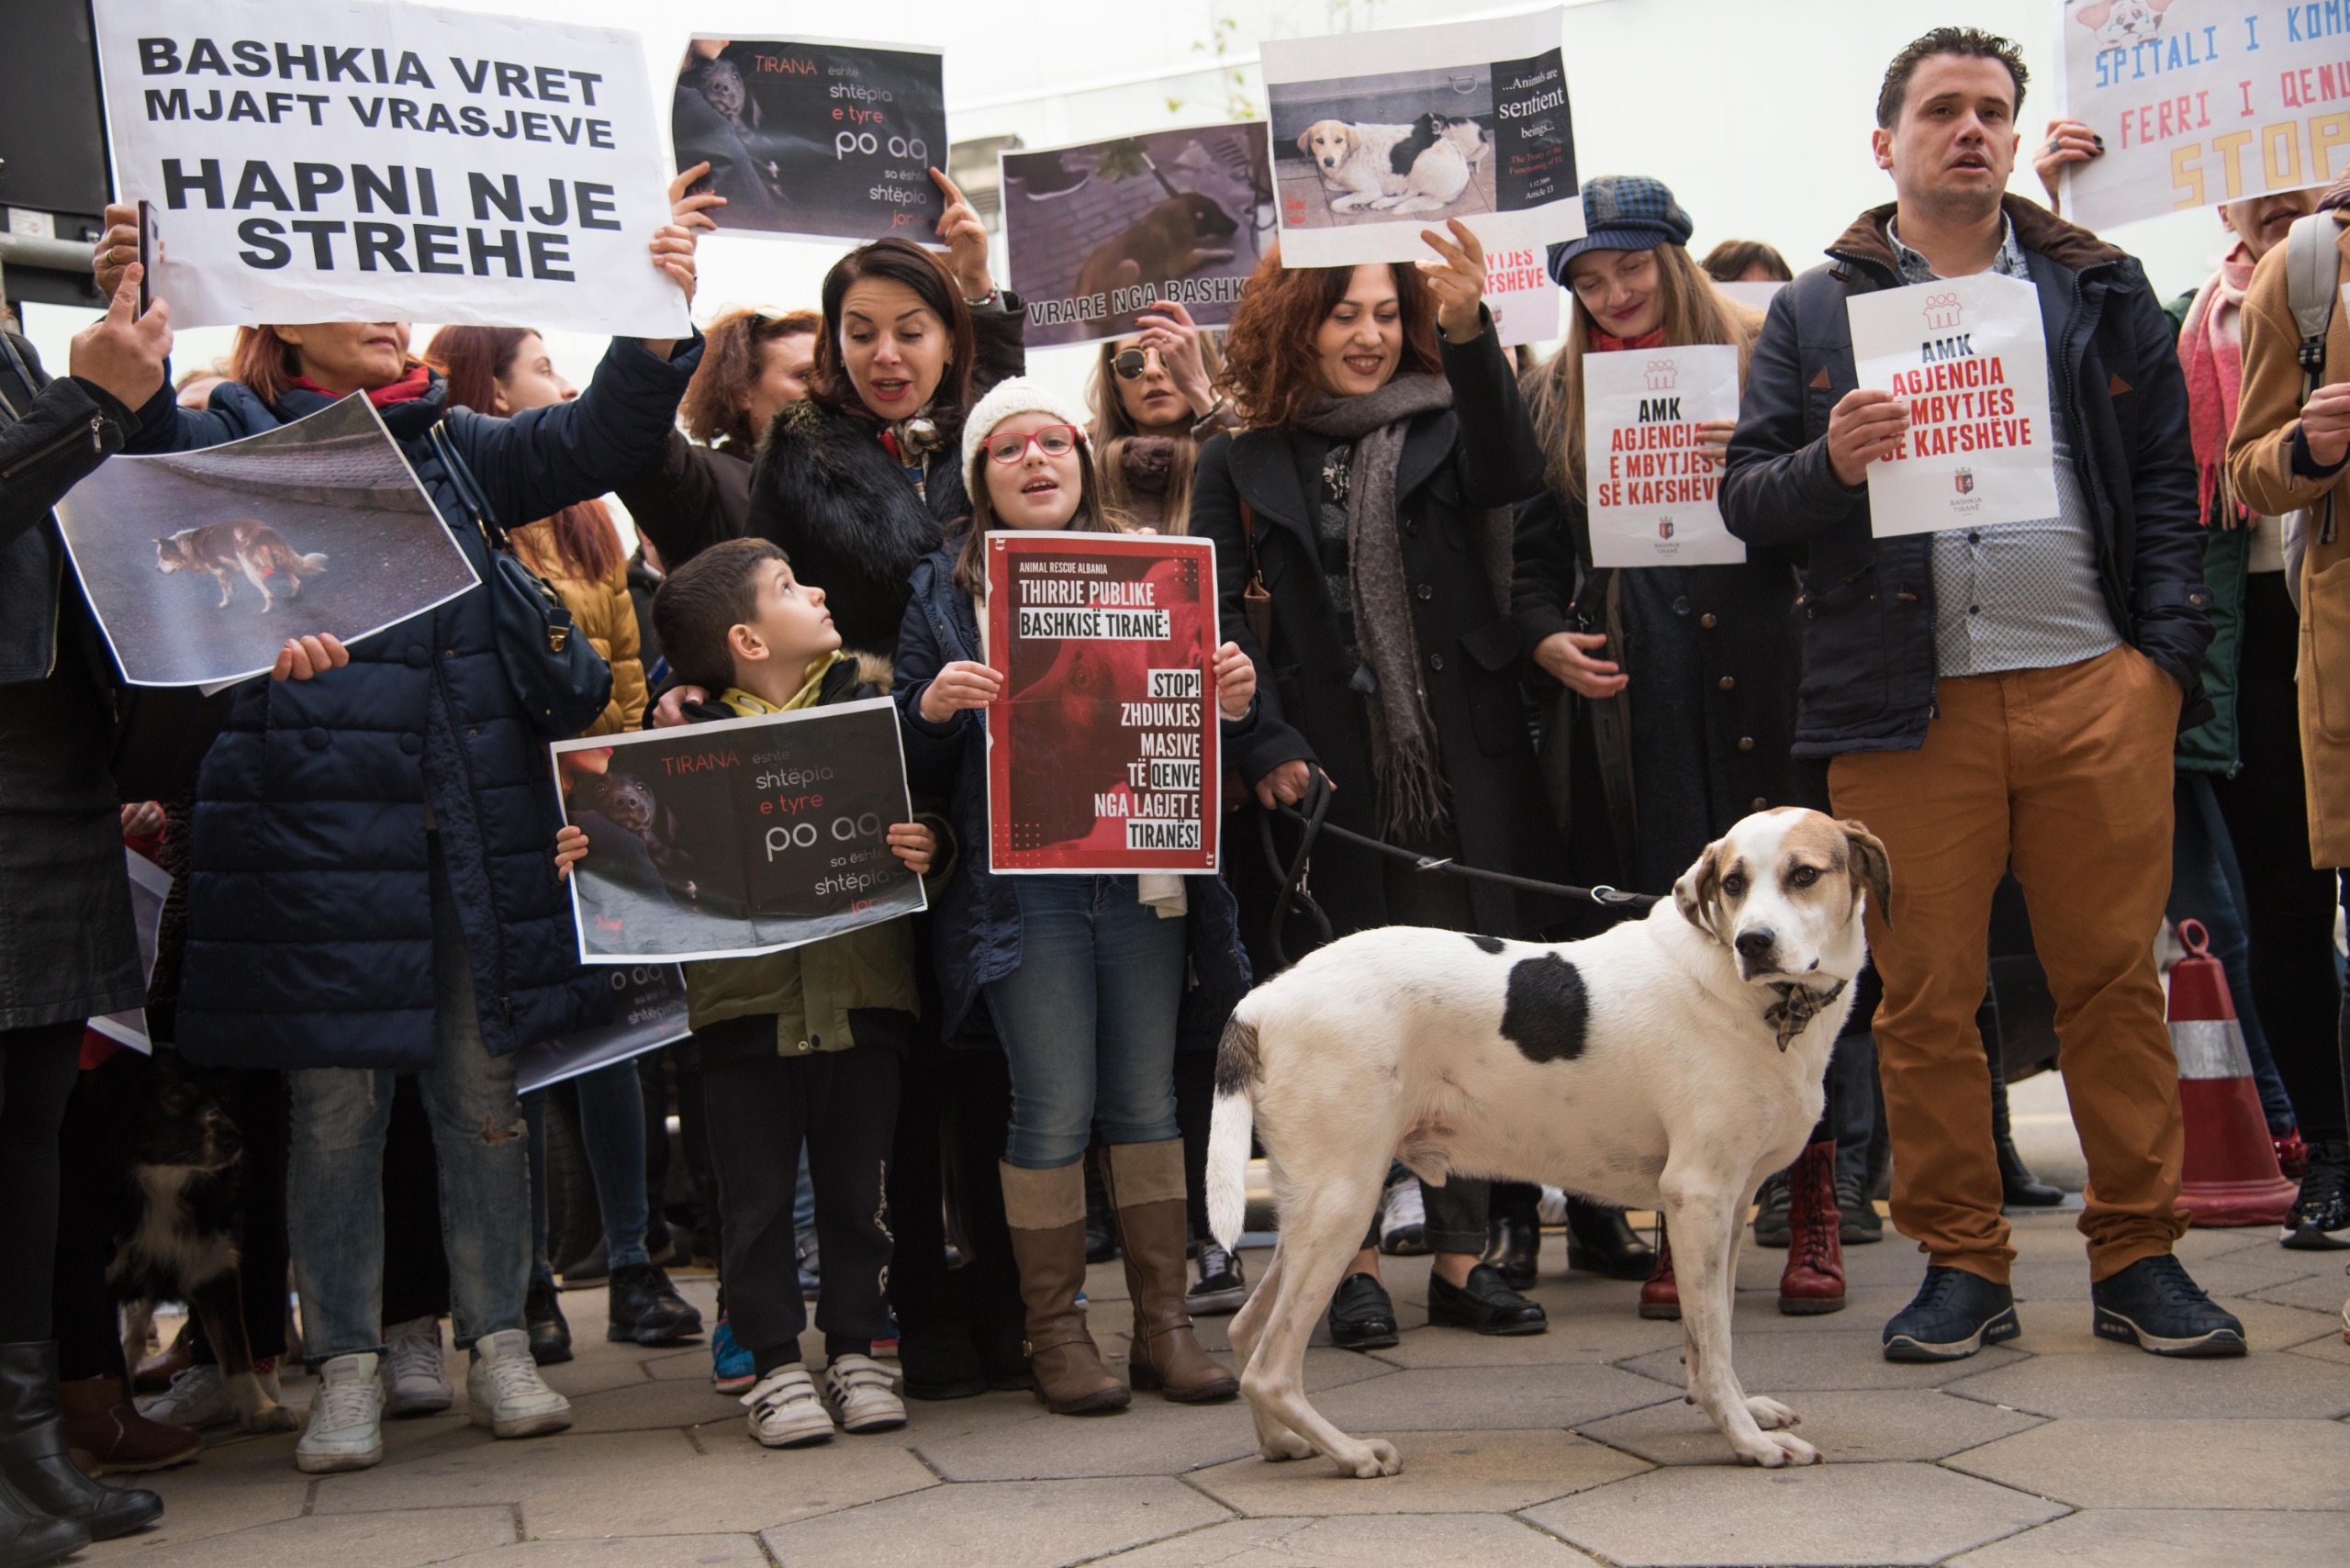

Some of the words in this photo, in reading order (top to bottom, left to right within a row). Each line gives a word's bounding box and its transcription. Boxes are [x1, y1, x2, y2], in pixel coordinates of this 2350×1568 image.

[755, 55, 817, 75] TIRANA
[2096, 26, 2218, 88] SPITALI
[2244, 15, 2259, 51] I
[138, 38, 434, 89] BASHKIA
[449, 56, 603, 106] VRET
[1546, 68, 1558, 79] are
[830, 83, 892, 104] shtëpia
[1499, 86, 1565, 119] sentient
[2121, 90, 2210, 150] FERRI
[2238, 80, 2255, 118] I
[2280, 60, 2350, 108] QENU
[144, 89, 329, 126] MJAFT
[350, 96, 615, 150] VRASJEVE
[832, 107, 844, 120] e
[848, 106, 884, 125] tyre
[1521, 123, 1555, 139] beings...
[835, 131, 878, 160] po
[888, 136, 928, 169] aq
[1511, 155, 1525, 163] The
[2170, 111, 2350, 211] STOP
[884, 170, 898, 179] sa
[162, 158, 438, 217] HAPNI
[467, 172, 621, 231] NJE
[869, 185, 927, 207] shtëpia
[1525, 188, 1546, 200] Article
[1547, 185, 1554, 194] 13
[237, 218, 576, 282] STREHE
[1483, 267, 1544, 295] FSHËVE
[1028, 293, 1107, 326] VRARE
[1112, 284, 1158, 314] NGA
[1165, 277, 1247, 303] BASHK
[1921, 333, 1975, 364] AMK
[1892, 356, 2004, 397] AGJENCIA
[1639, 397, 1682, 423] AMK
[1910, 387, 2015, 426] MBYTJES
[1611, 422, 1706, 452] AGJENCIA
[1914, 418, 2032, 458] KAFSHËVE
[1609, 456, 1619, 479] E
[1626, 450, 1714, 478] MBYTJES
[1598, 480, 1622, 507] SË
[1628, 476, 1723, 505] KAFSHËV
[1950, 497, 1983, 507] BASHKIA
[1019, 562, 1048, 574] ANIMAL
[1049, 562, 1077, 574] RESCUE
[1078, 563, 1108, 575] ALBANIA
[1019, 579, 1085, 604] THIRRJE
[1089, 581, 1156, 606] PUBLIKE
[1021, 608, 1102, 637] BASHKISË
[1105, 609, 1169, 638] TIRANË:
[1154, 673, 1201, 697] STOP!
[1121, 702, 1201, 727] ZHDUKJES
[1140, 733, 1201, 757] MASIVE
[661, 750, 741, 777] TIRANA
[752, 748, 790, 765] është
[1127, 758, 1147, 787] TË
[1151, 763, 1201, 789] QENVE
[755, 764, 834, 790] shtëpia
[760, 801, 773, 815] e
[778, 792, 823, 814] tyre
[1094, 793, 1130, 818] NGA
[1134, 793, 1188, 818] LAGJET
[1191, 793, 1200, 818] E
[765, 823, 818, 862] po
[831, 812, 885, 844] aq
[1129, 819, 1199, 848] TIRANËS!
[830, 857, 846, 868] sa
[814, 868, 890, 896] shtëpia
